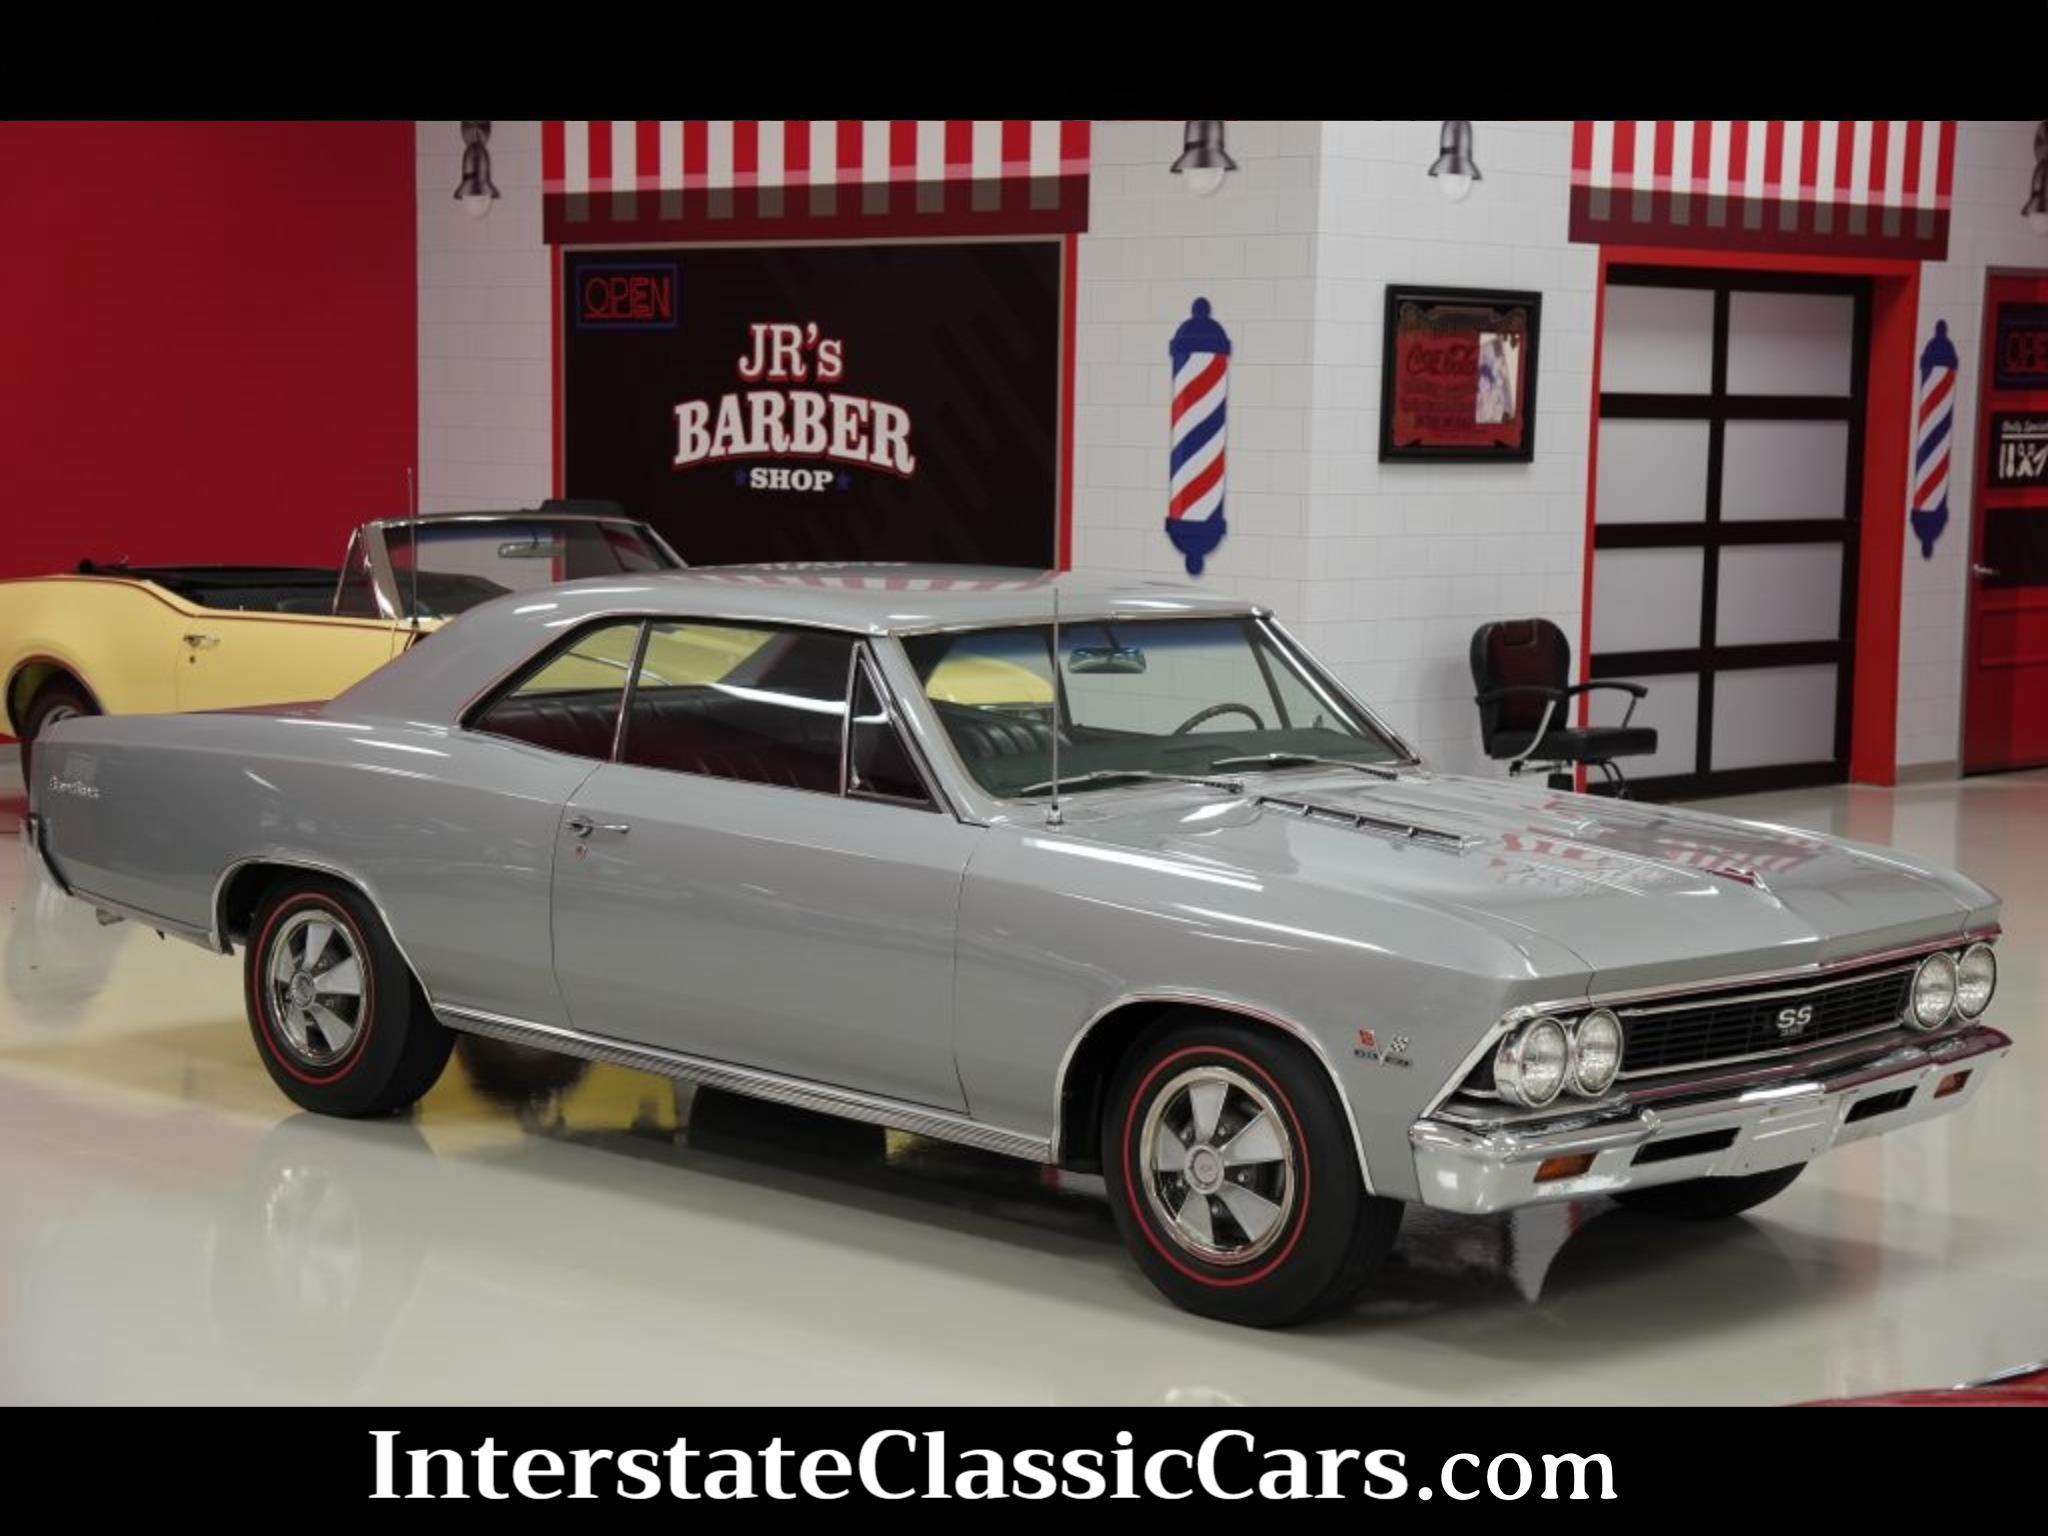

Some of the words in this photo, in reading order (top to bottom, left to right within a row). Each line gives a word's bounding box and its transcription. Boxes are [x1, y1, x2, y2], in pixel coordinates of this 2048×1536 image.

[584, 276, 672, 318] OPEN
[738, 322, 842, 378] JR's
[674, 390, 916, 475] BARBER
[750, 467, 834, 492] SHOP
[1777, 1005, 1813, 1029] SS
